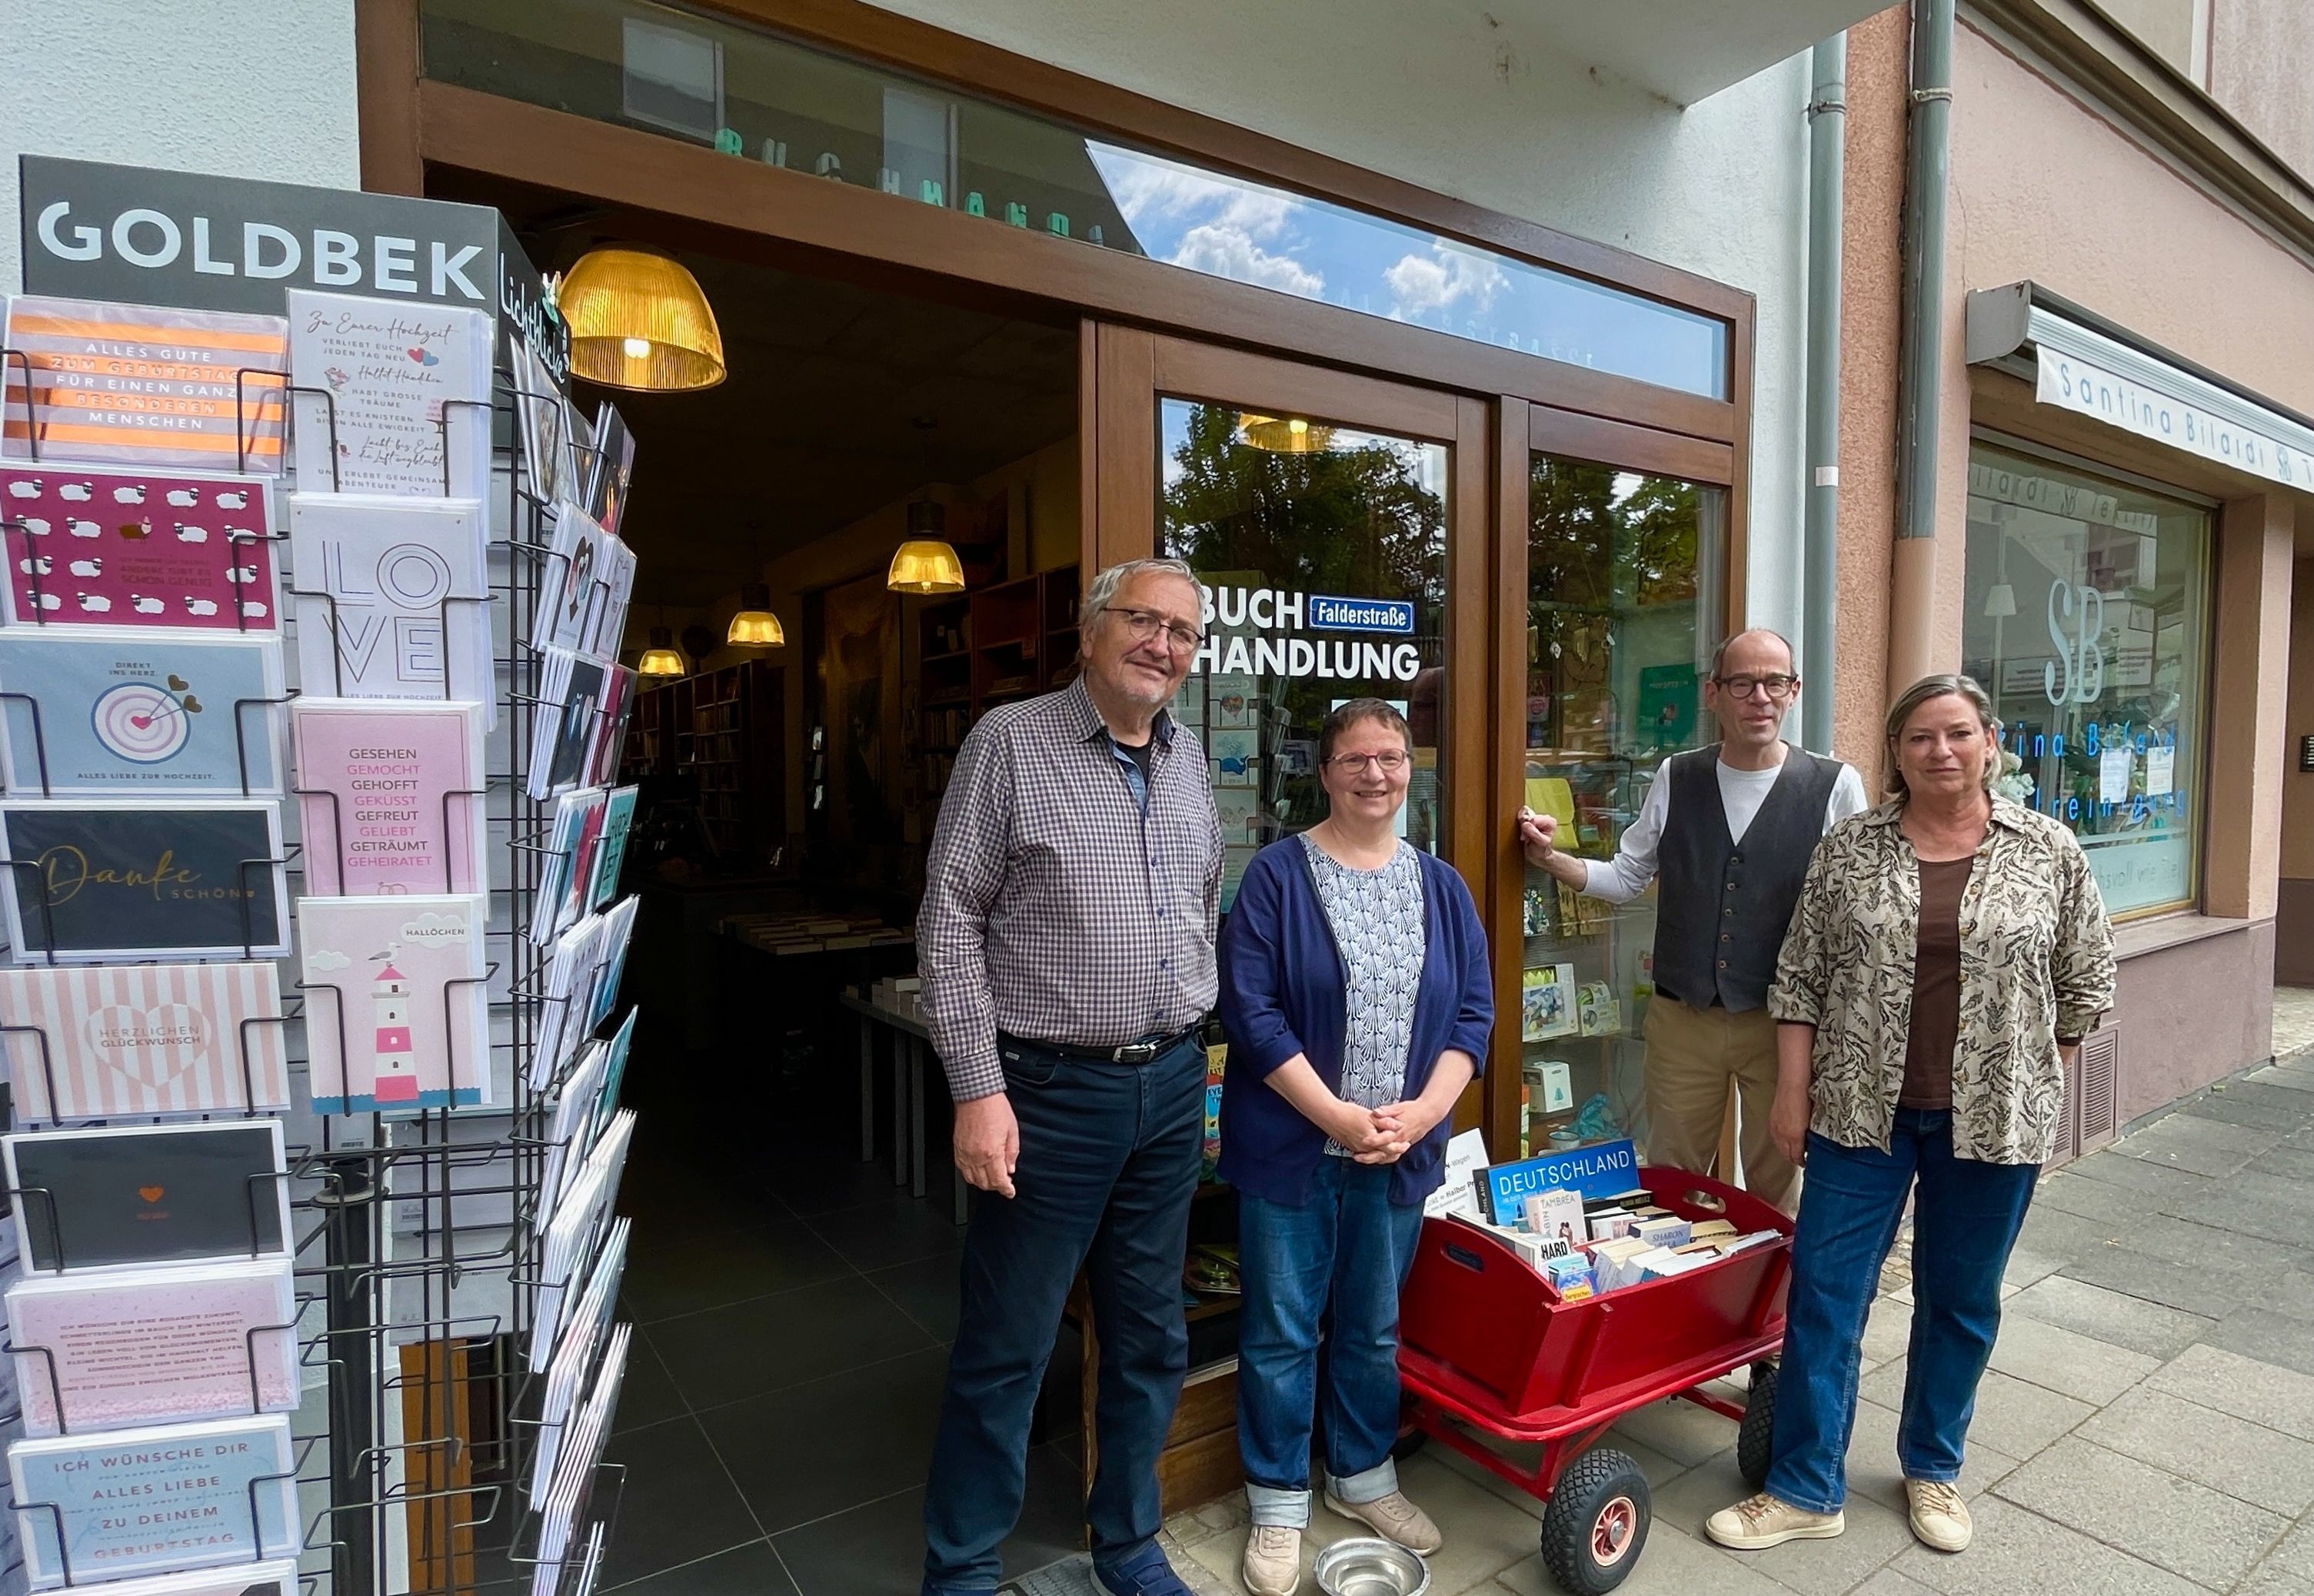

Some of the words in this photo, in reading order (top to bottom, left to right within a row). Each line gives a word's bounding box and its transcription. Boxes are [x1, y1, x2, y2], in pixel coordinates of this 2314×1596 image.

[37, 200, 486, 300] GOLDBEK
[308, 310, 332, 333] Zu
[336, 312, 383, 334] Eurer
[388, 318, 460, 344] Hochzeit
[322, 337, 370, 349] VERLIEBT
[376, 343, 402, 352] EUCH
[85, 343, 148, 358] ALLES
[159, 348, 211, 362] GUTE
[323, 347, 355, 357] JEDEN
[361, 351, 380, 360] TAG
[385, 354, 405, 362] NEU
[52, 356, 95, 371] ZUM
[108, 361, 238, 381] GEBURTSTAG
[55, 374, 94, 388] FÜR
[108, 380, 170, 394] EINEN
[183, 385, 236, 398] GANZ
[352, 387, 379, 397] HABT
[383, 391, 422, 401] GROSSE
[2060, 362, 2172, 434] Santina
[77, 393, 216, 414] BESONDEREN
[361, 397, 401, 409] TRÄUME
[88, 411, 202, 430] MENSCHEN
[315, 408, 345, 417] LAST
[350, 410, 361, 418] ES
[365, 413, 414, 423] KNISTERN
[351, 421, 374, 430] ALLE
[378, 423, 425, 434] EWIGKEIT
[345, 470, 381, 480] ERLEBT
[323, 540, 451, 610] LO
[1202, 584, 1303, 630] BUCH
[1318, 601, 1407, 627] Falderstraße
[321, 614, 444, 683] VE
[2045, 577, 2104, 707] SB
[115, 661, 151, 670] DIREKT
[1192, 634, 1420, 682] HANDLUNG
[349, 748, 417, 760] GESEHEN
[347, 764, 421, 776] GEMOCHT
[351, 780, 419, 790] GEHOFFT
[354, 794, 418, 806] GEKÜSST
[355, 810, 419, 821] GEFREUT
[359, 826, 416, 837] GELIEBT
[350, 840, 428, 852] GETRÄUMT
[348, 856, 432, 867] GEHEIRATET
[38, 844, 202, 906] Danke
[171, 886, 240, 899] SCHÖN
[406, 927, 465, 937] HALLÖCHEN
[99, 1025, 199, 1036] HERZLICHEN
[101, 1036, 201, 1049] GLÜCKWUNSCH
[1499, 1149, 1630, 1195] DEUTSCHLAND
[1540, 1194, 1575, 1209] TAMBREA
[1653, 1229, 1684, 1242] SHARON
[1540, 1241, 1569, 1261] HARD
[55, 1460, 90, 1473] ICH
[101, 1447, 205, 1469] WÜNSCHE
[215, 1442, 249, 1456] DIR
[92, 1483, 154, 1500] ALLES
[165, 1475, 221, 1492] LIEBE
[102, 1518, 127, 1530] ZU
[138, 1506, 219, 1526] DEINEM
[94, 1532, 235, 1560] GEBURTSTAG
